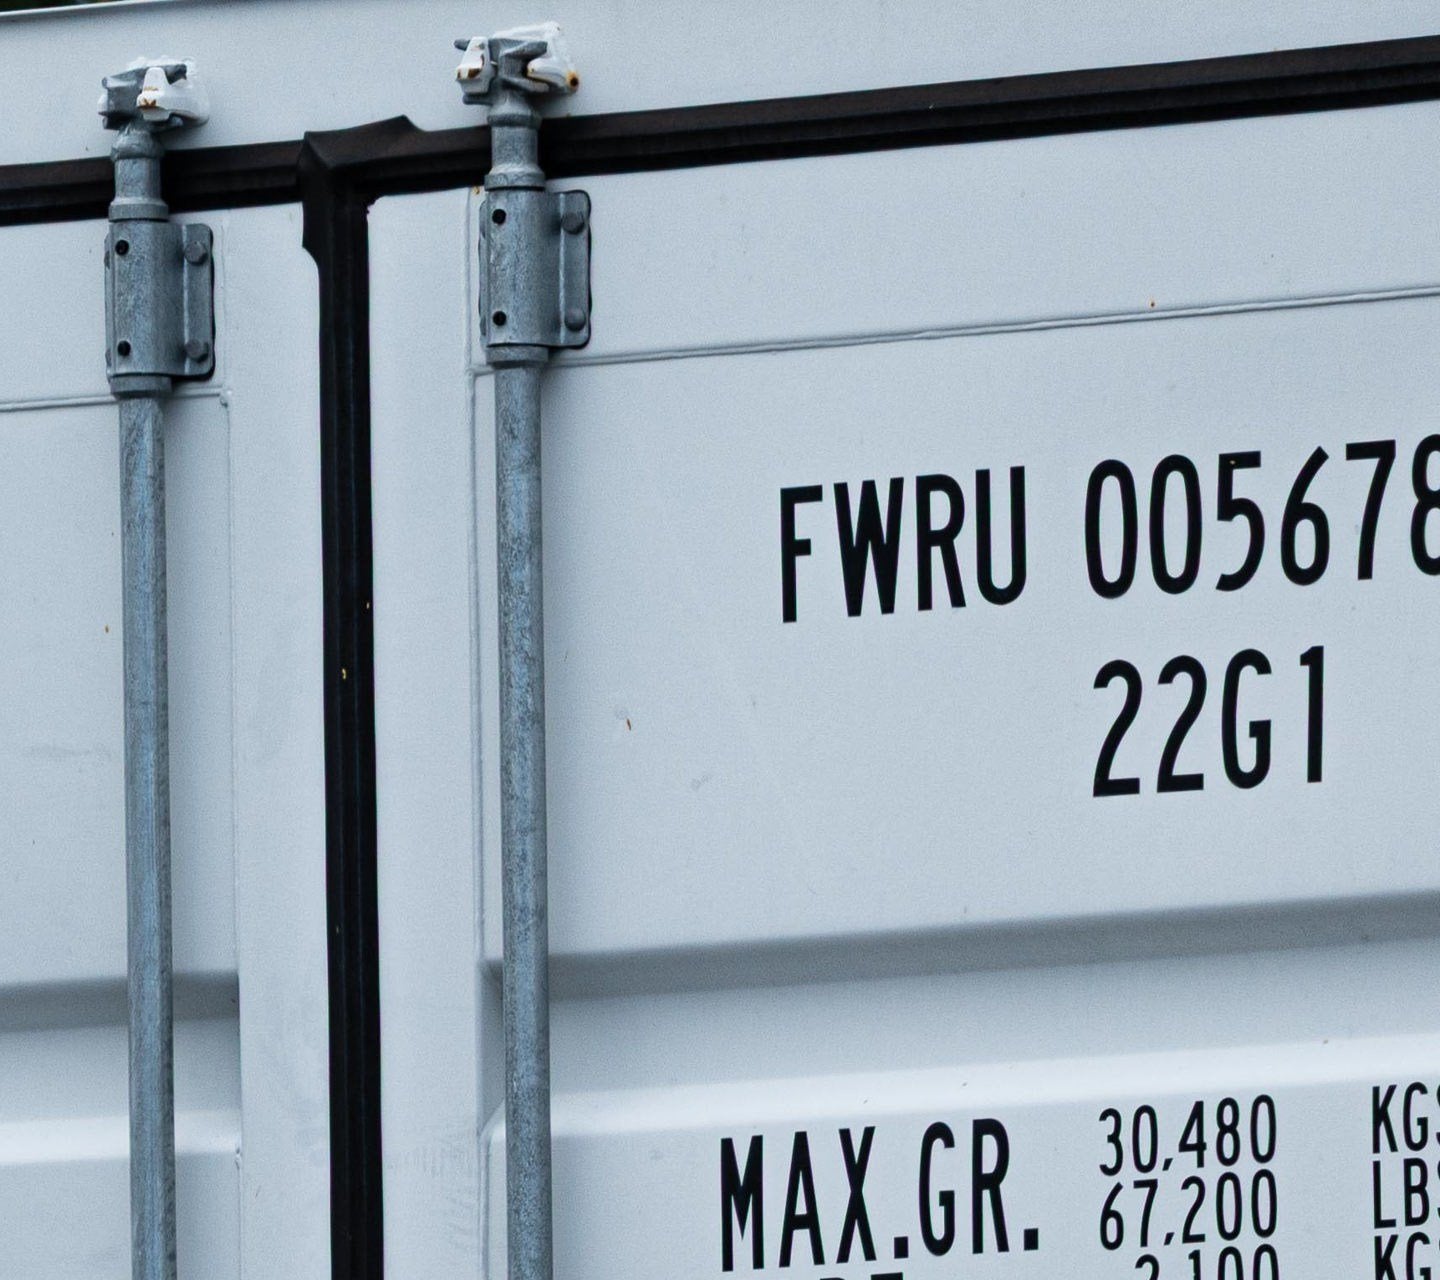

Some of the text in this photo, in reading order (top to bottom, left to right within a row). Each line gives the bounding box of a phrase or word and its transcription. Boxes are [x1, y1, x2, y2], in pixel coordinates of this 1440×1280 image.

[780, 433, 1440, 624] FWRU 005678
[1093, 644, 1325, 797] 22G1
[720, 1081, 1440, 1273] MAX.GR. 30,480 KG
[1099, 1157, 1440, 1252] 67,200 LB
